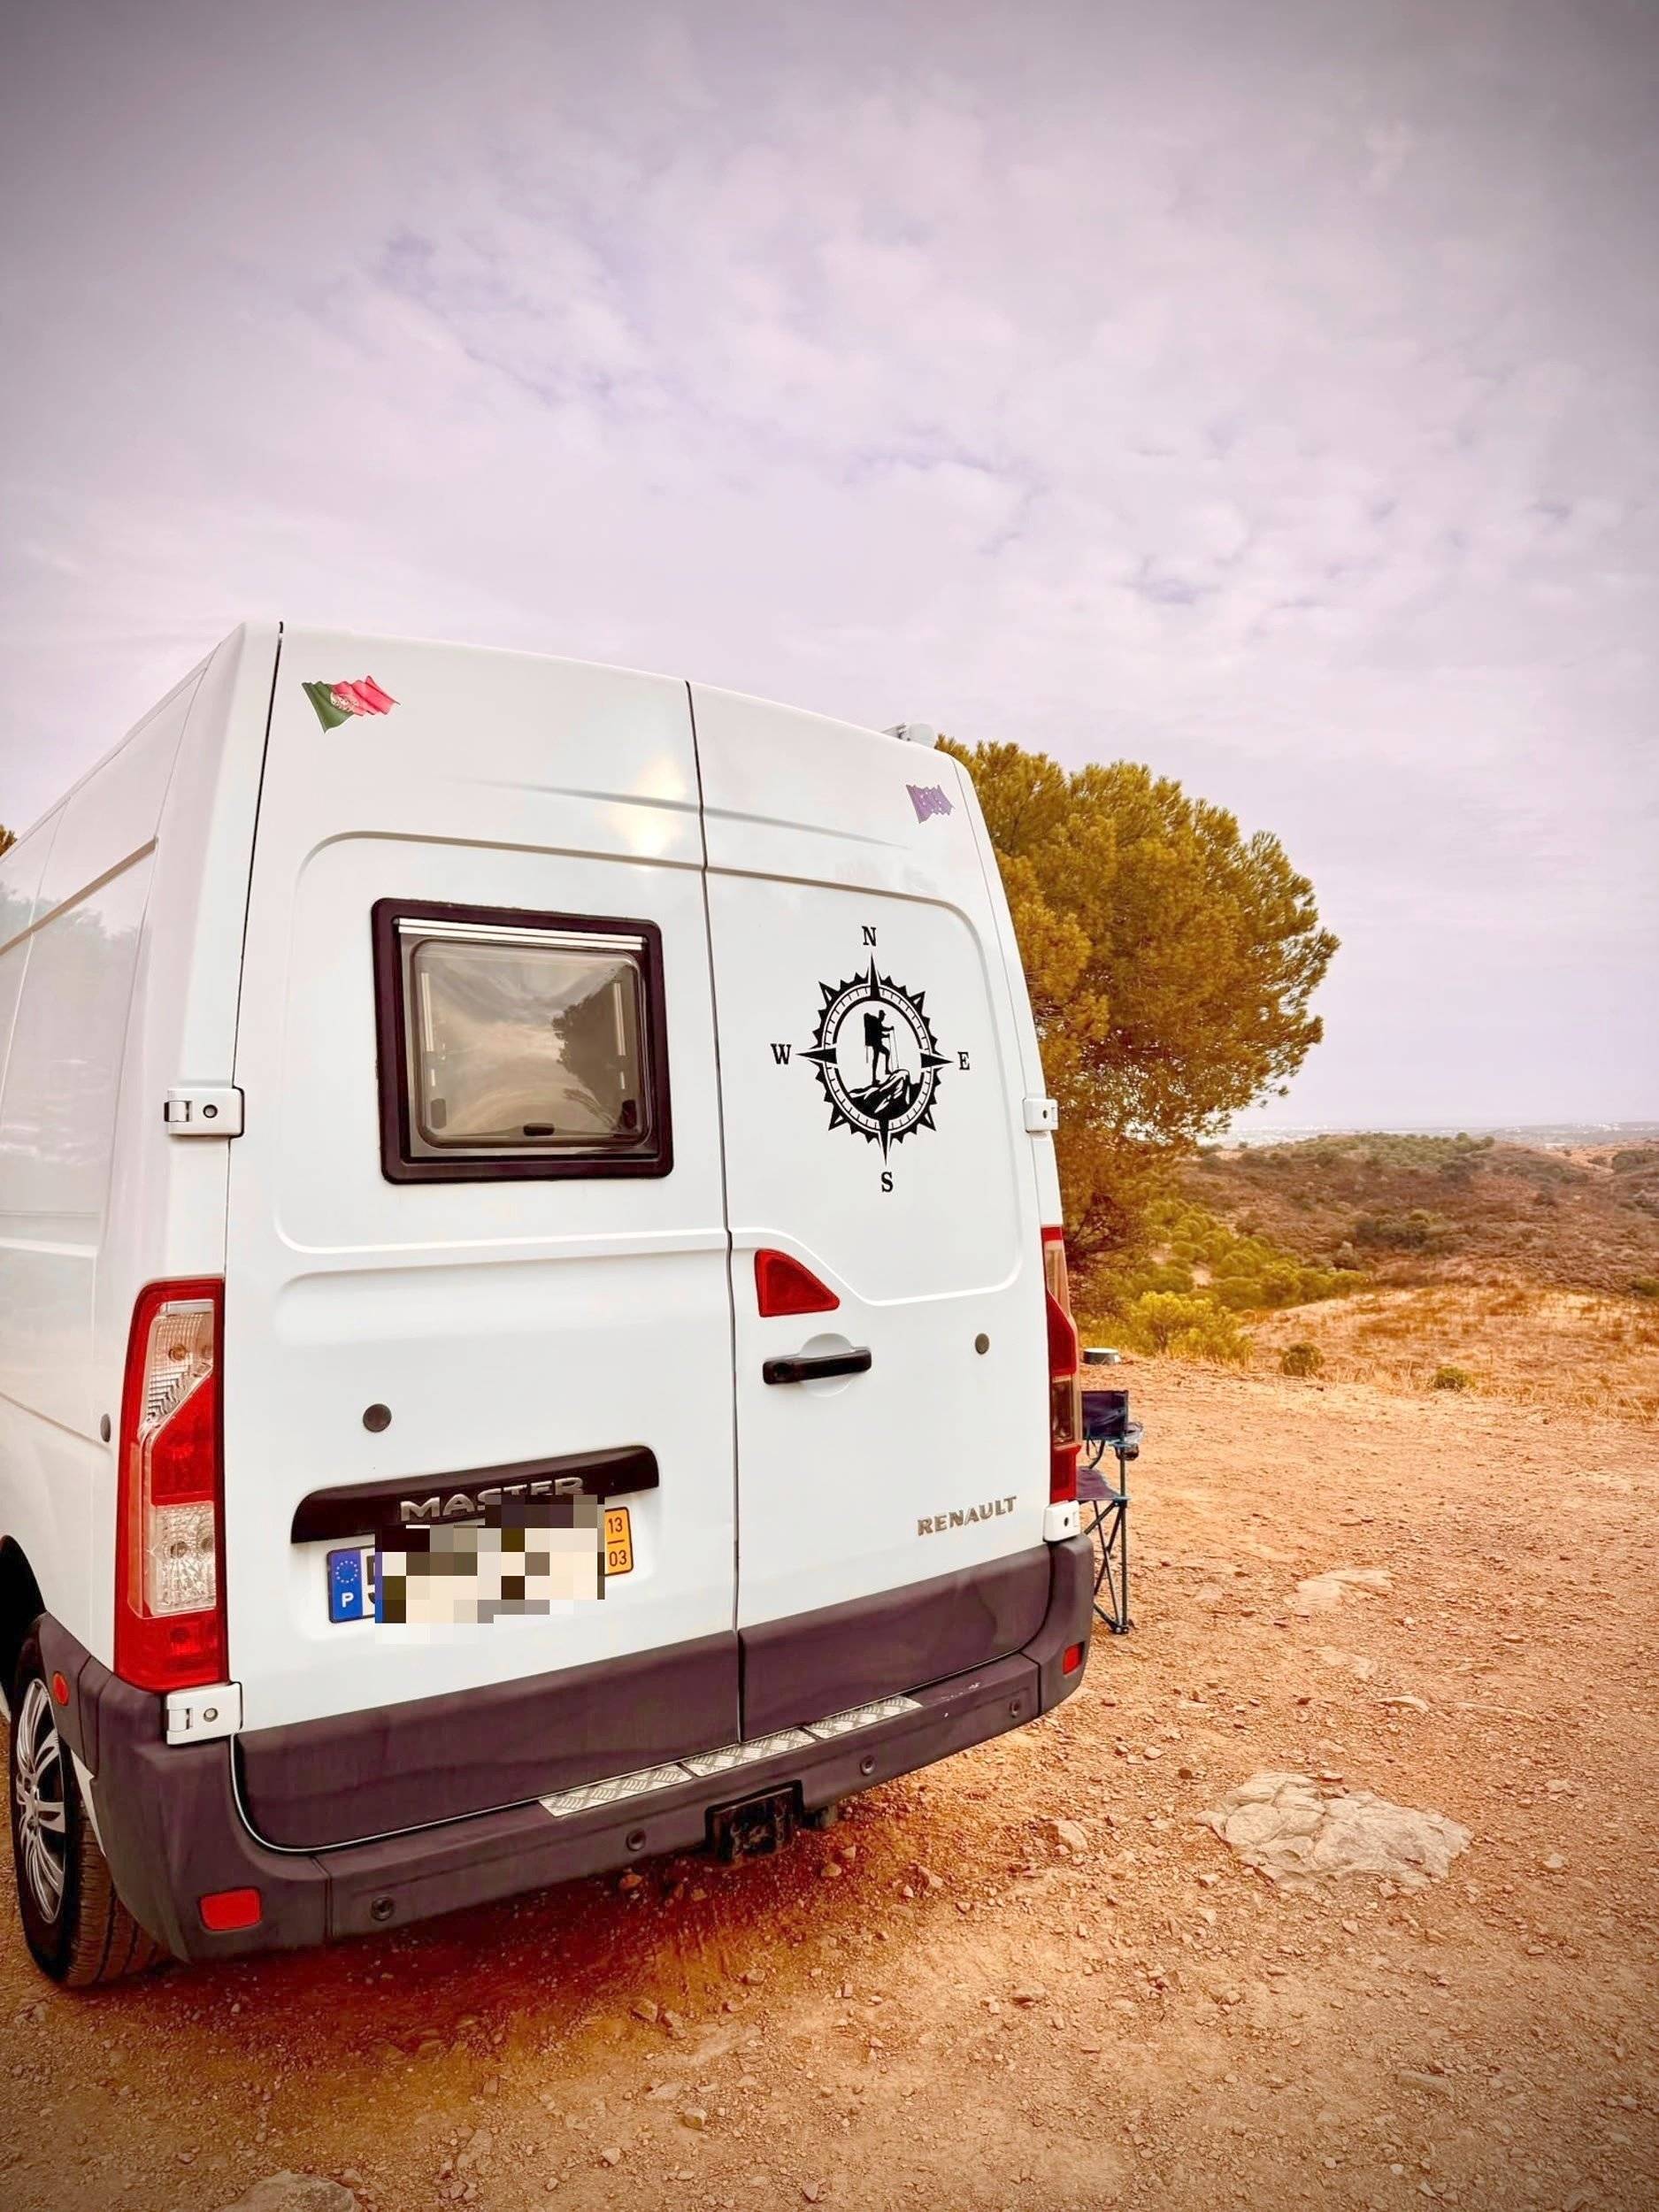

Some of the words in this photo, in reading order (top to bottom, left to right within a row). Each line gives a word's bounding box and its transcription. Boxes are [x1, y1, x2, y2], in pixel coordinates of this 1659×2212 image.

[862, 926, 877, 947] N
[771, 1043, 792, 1065] W
[957, 1051, 971, 1071] E
[880, 1171, 894, 1193] S
[608, 1517, 623, 1533] 13
[917, 1495, 1017, 1536] RENAULT
[609, 1549, 627, 1567] 03
[342, 1592, 354, 1609] P
